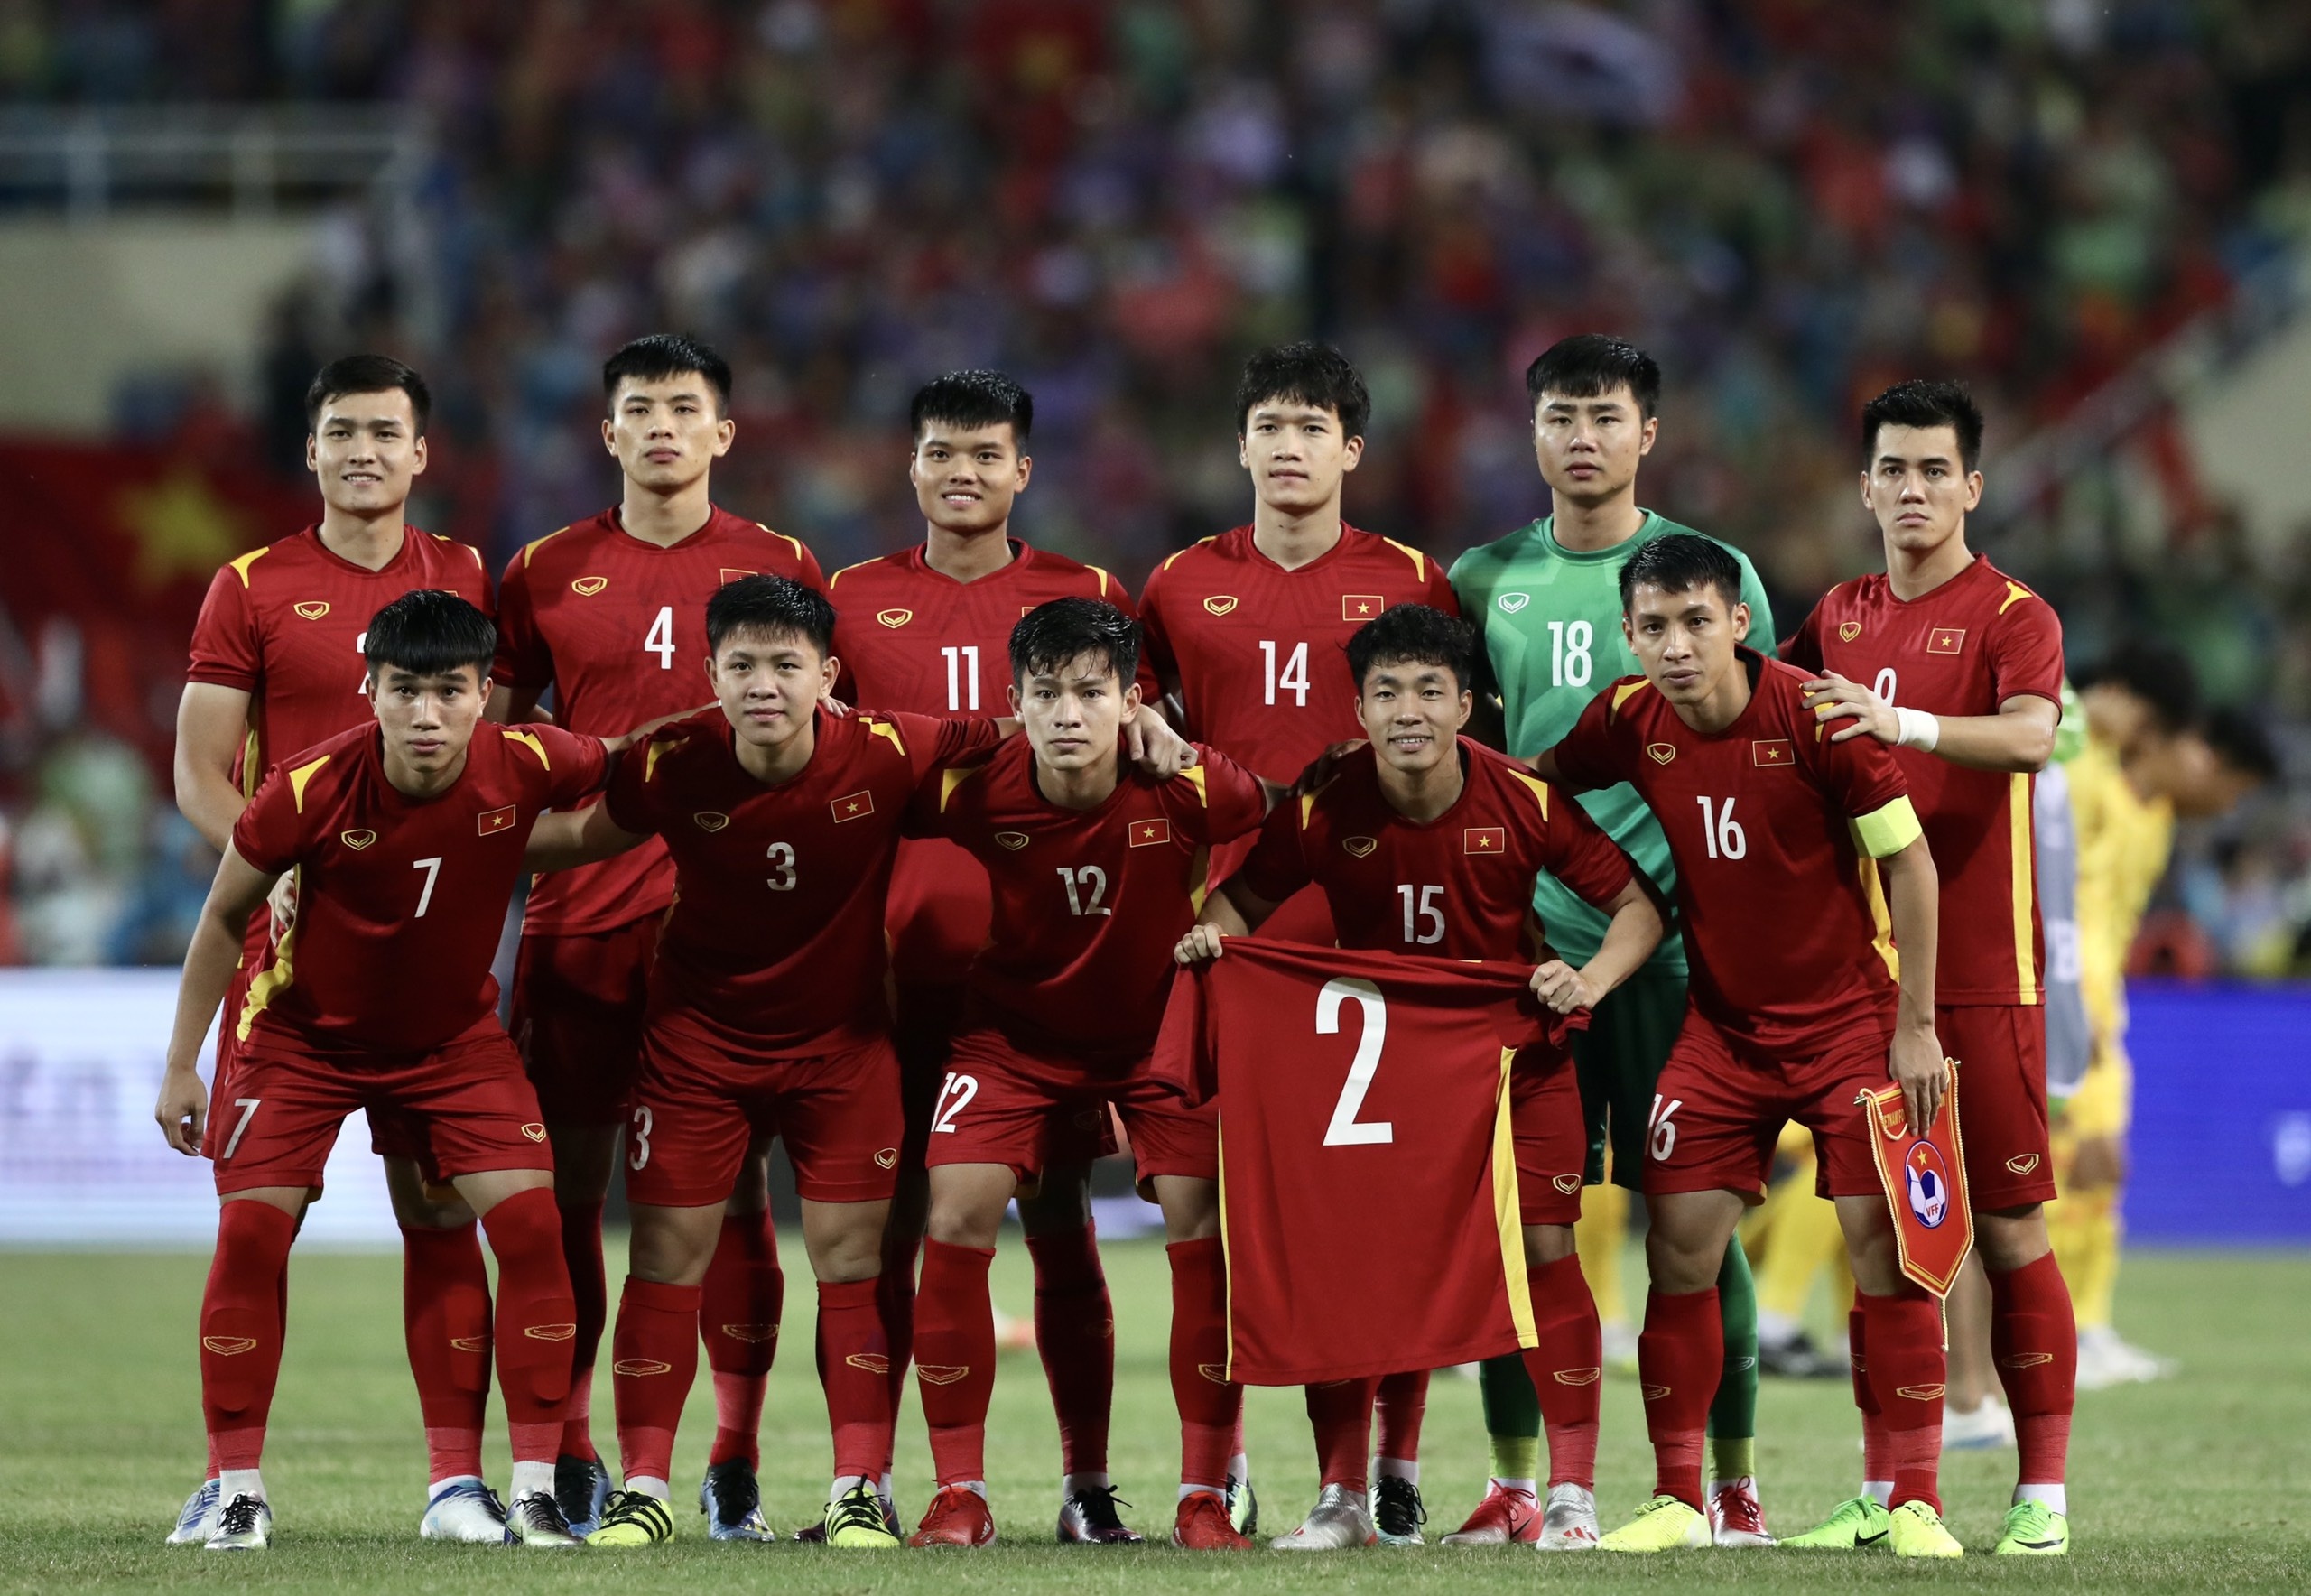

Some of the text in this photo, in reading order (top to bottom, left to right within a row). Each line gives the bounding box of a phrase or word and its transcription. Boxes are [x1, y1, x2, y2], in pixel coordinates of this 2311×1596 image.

[644, 606, 676, 670] 4
[1547, 619, 1593, 688] 18
[941, 645, 979, 711] 11
[1258, 640, 1312, 707] 14
[1696, 795, 1747, 860] 16
[413, 857, 442, 919] 7
[766, 841, 797, 891] 3
[1056, 865, 1112, 916] 12
[1397, 884, 1445, 944] 15
[1315, 977, 1393, 1146] 2
[223, 1098, 262, 1159] 7
[931, 1072, 979, 1134] 12
[1644, 1093, 1683, 1161] 16
[630, 1105, 653, 1171] 3
[1926, 1202, 1940, 1218] VFF
